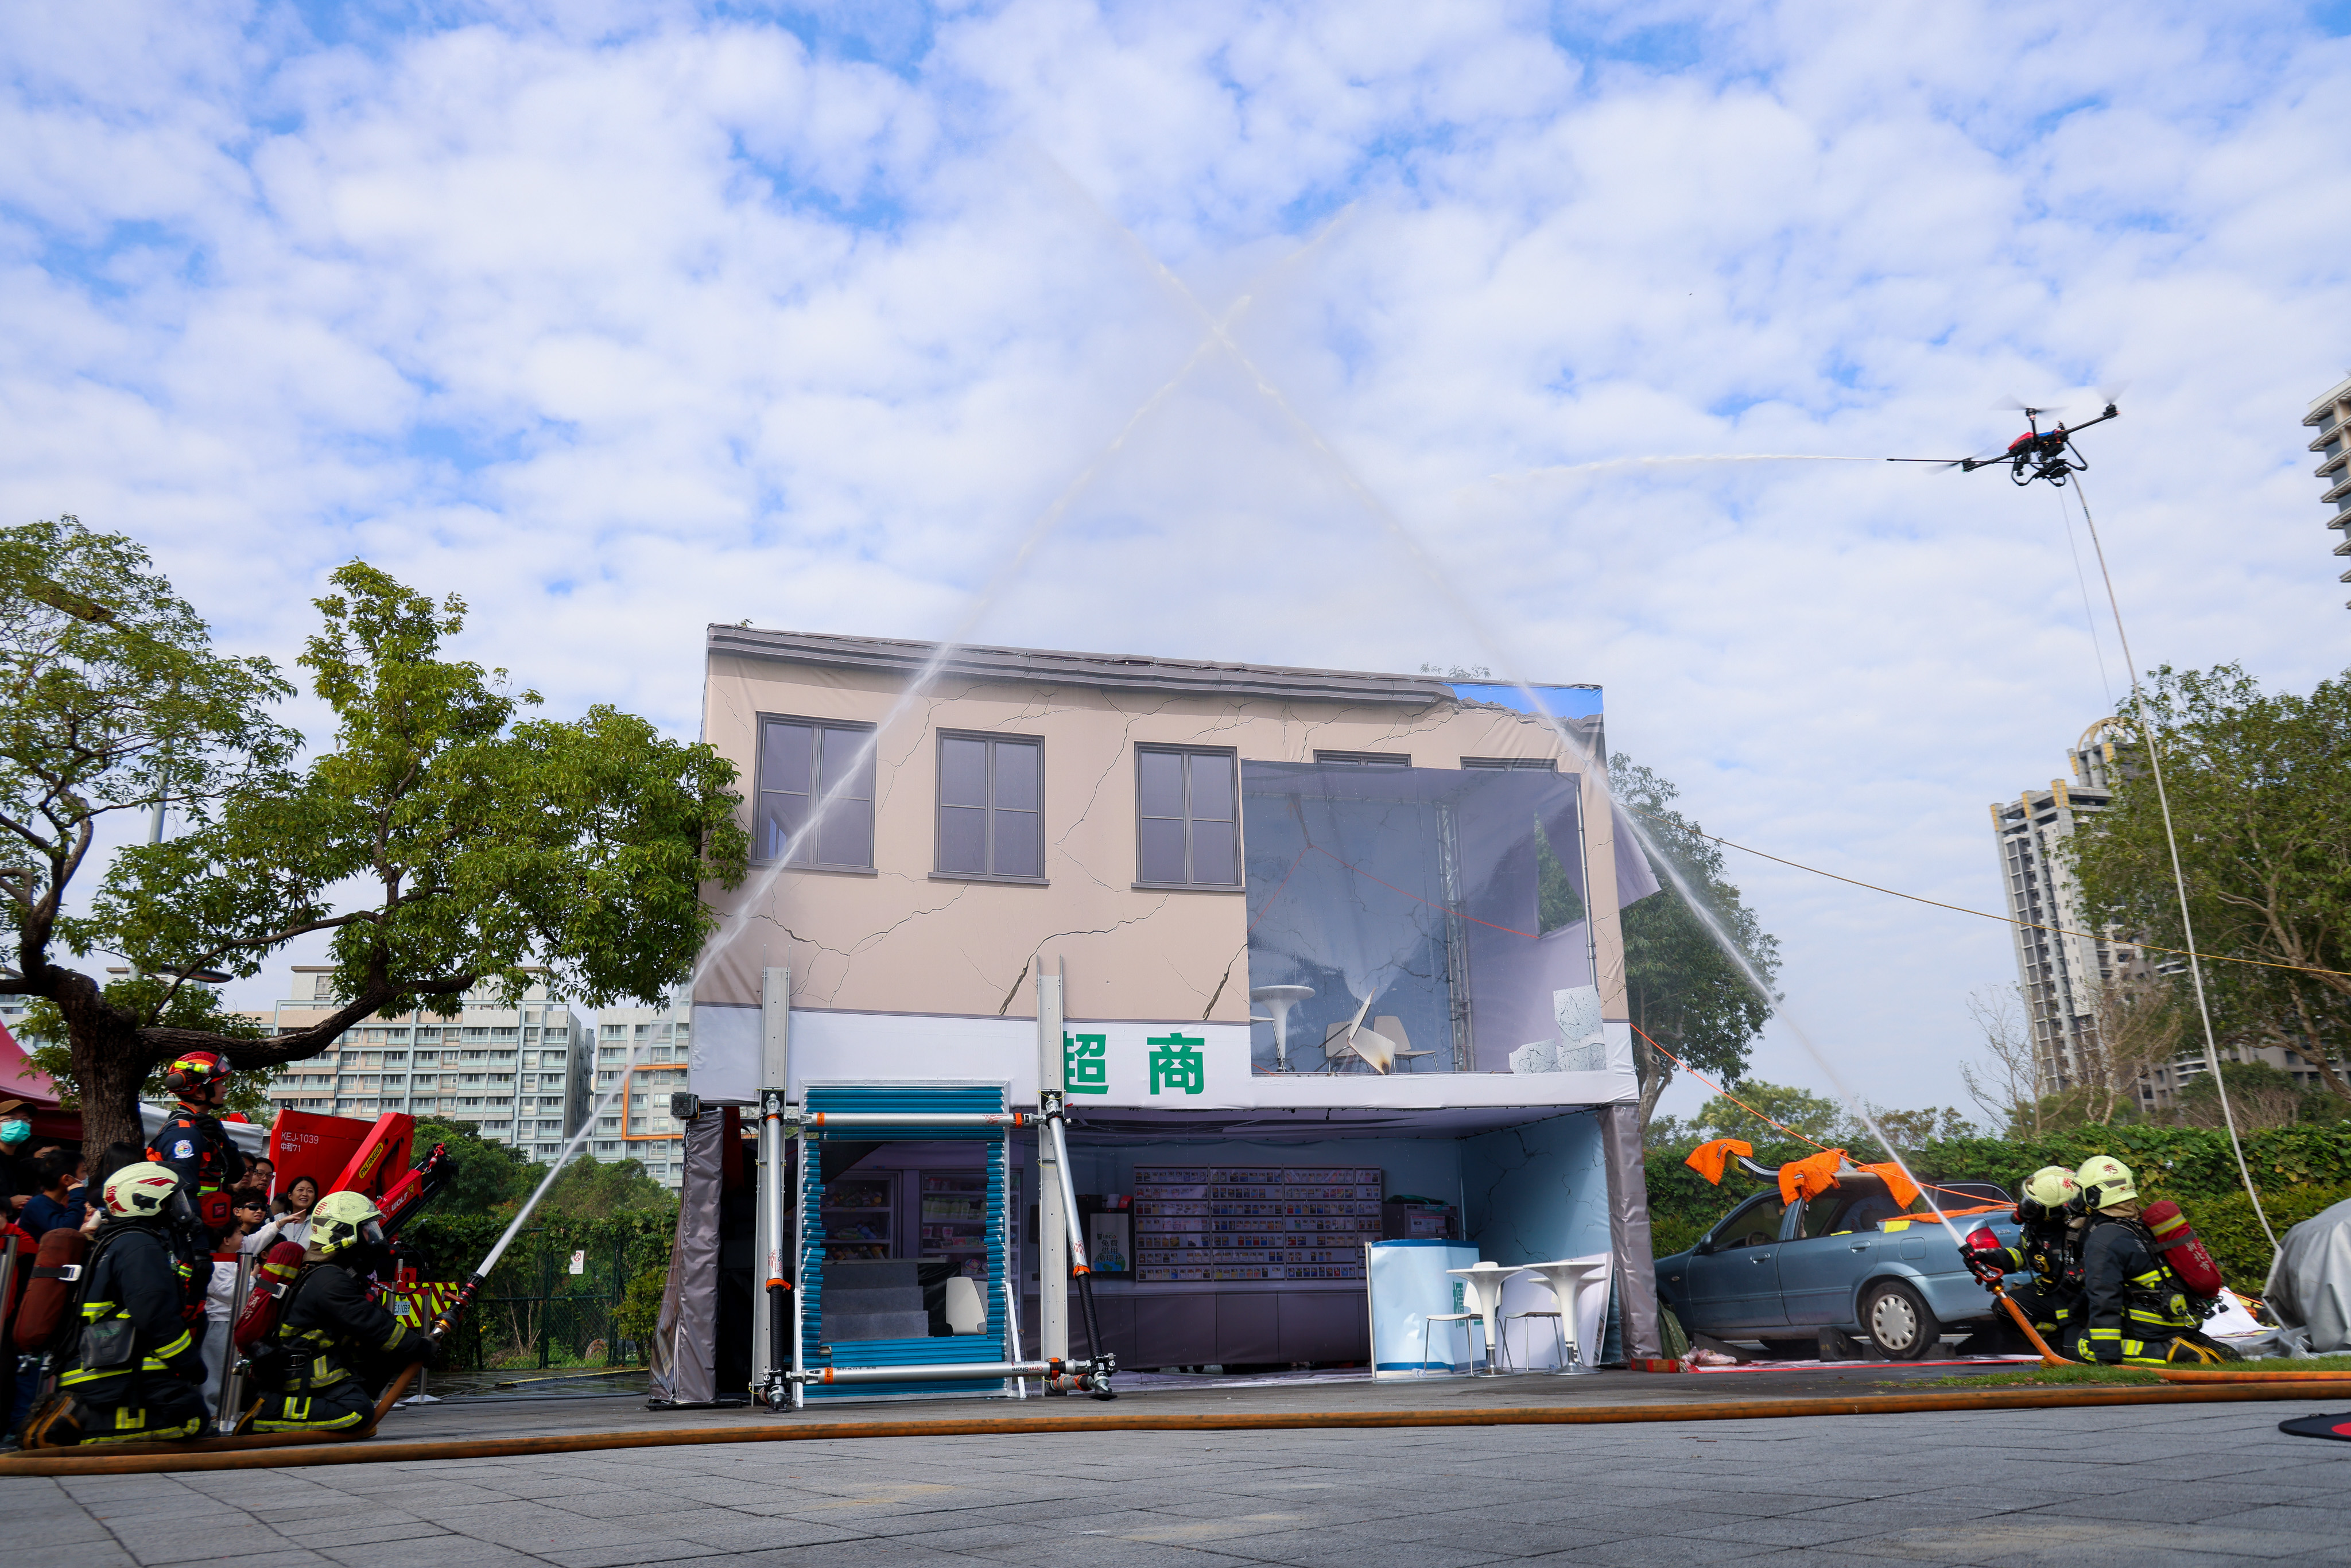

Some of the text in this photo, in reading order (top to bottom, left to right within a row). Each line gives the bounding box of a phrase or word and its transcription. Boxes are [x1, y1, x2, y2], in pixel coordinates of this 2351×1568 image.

[1063, 1031, 1205, 1095] 超商
[281, 1131, 319, 1144] KEJ-1039
[281, 1142, 301, 1152] 中和71
[359, 1144, 383, 1177] PALFINGER
[391, 1191, 409, 1212] WOLF
[1101, 1247, 1118, 1255] 借用
[1097, 1254, 1123, 1262] 循環杯
[394, 1304, 410, 1313] EJ-1039
